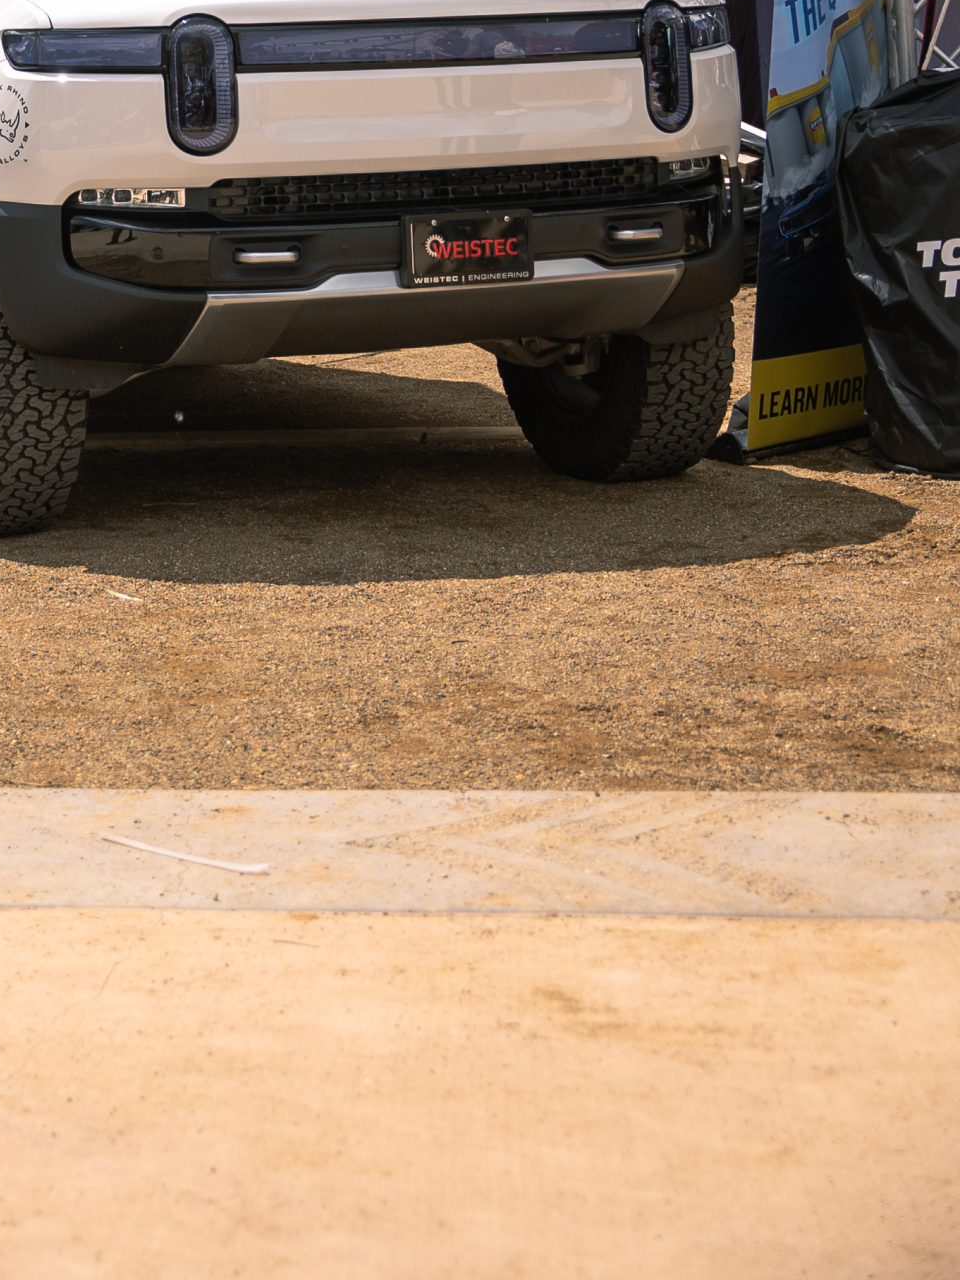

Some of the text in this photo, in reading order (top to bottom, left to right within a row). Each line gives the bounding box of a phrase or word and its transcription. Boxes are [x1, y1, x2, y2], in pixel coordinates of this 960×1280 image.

[7, 85, 29, 114] RHINO
[433, 237, 519, 259] WEISTEC
[414, 271, 529, 284] WEISTEC ENGINEERING
[759, 375, 866, 420] LEARN MOR
